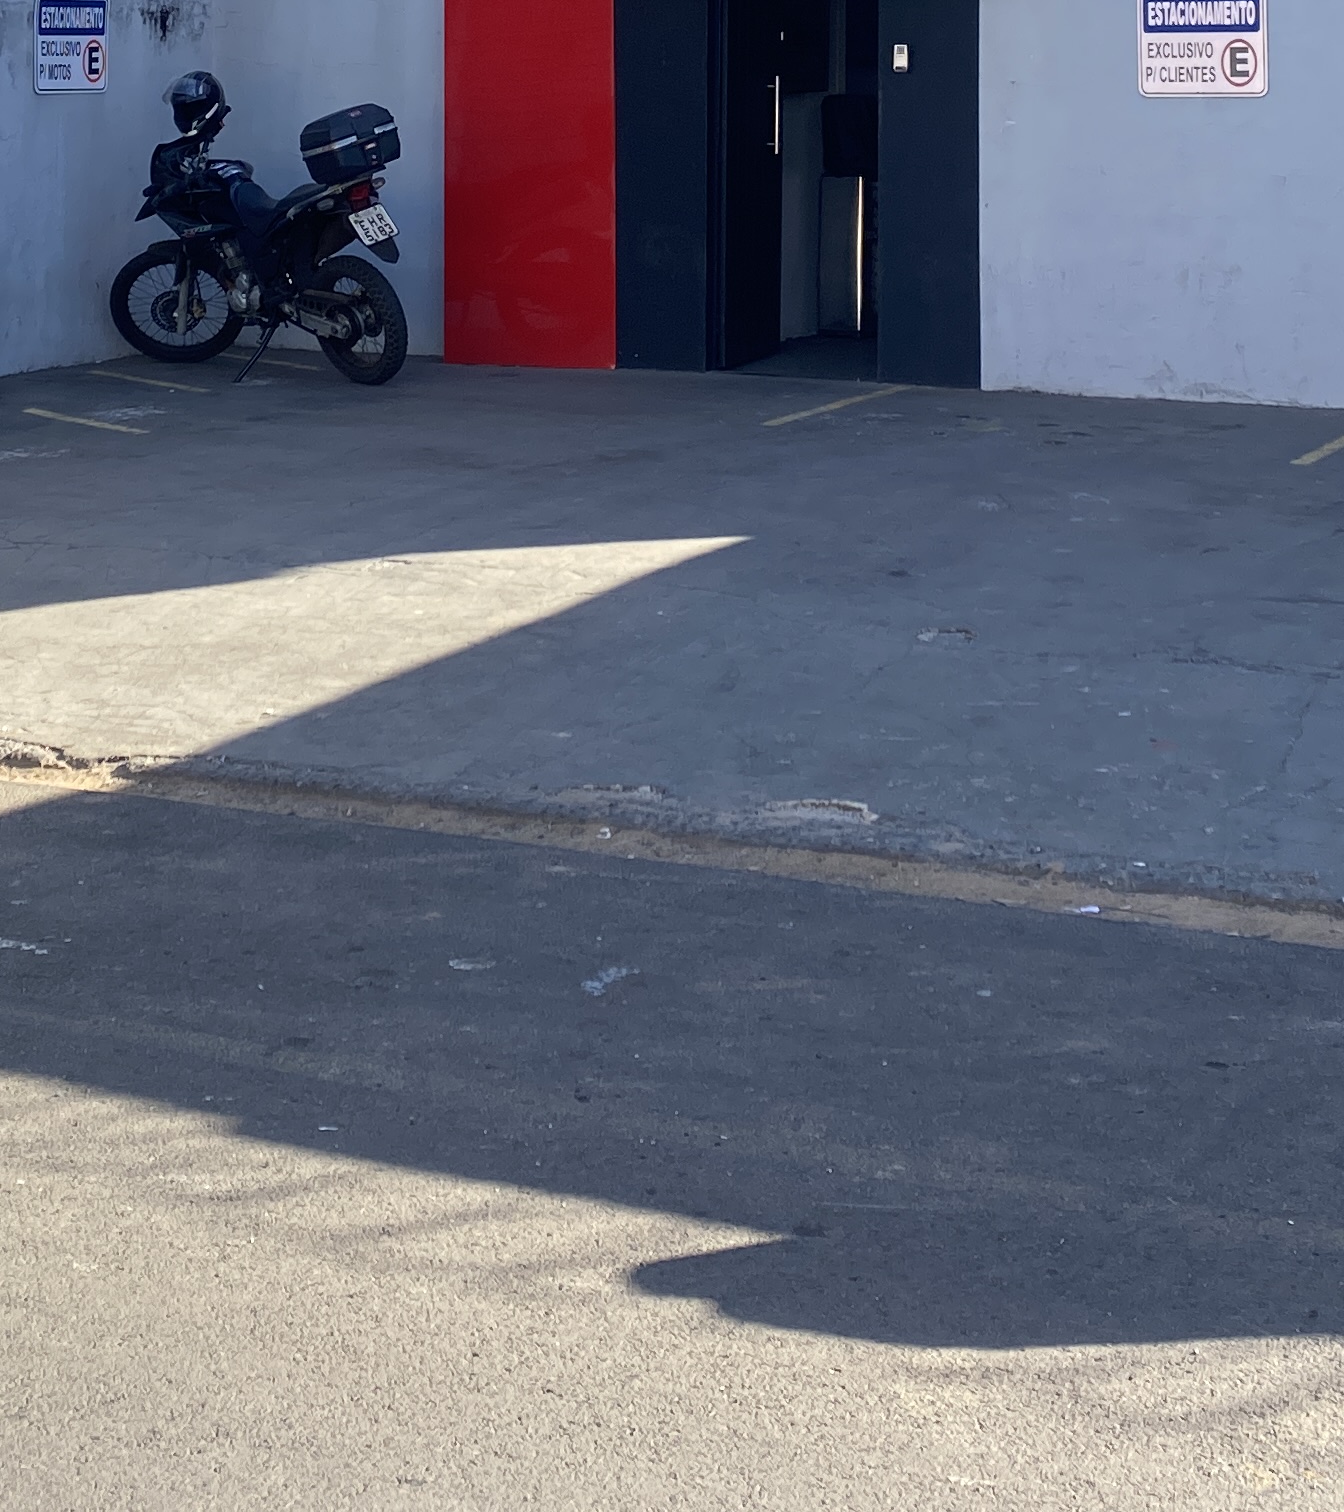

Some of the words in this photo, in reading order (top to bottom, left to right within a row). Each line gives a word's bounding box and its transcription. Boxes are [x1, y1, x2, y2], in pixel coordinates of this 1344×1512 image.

[41, 7, 104, 28] ESTACIONAMENTO
[1147, 1, 1256, 26] ESTACIONAMENTO
[41, 41, 81, 56] EXCLUSIVO
[88, 47, 99, 75] E
[1147, 42, 1213, 58] EXCLUSIVO
[1230, 47, 1249, 77] E
[48, 64, 71, 80] MOTOS
[1159, 66, 1216, 82] CLIENTES
